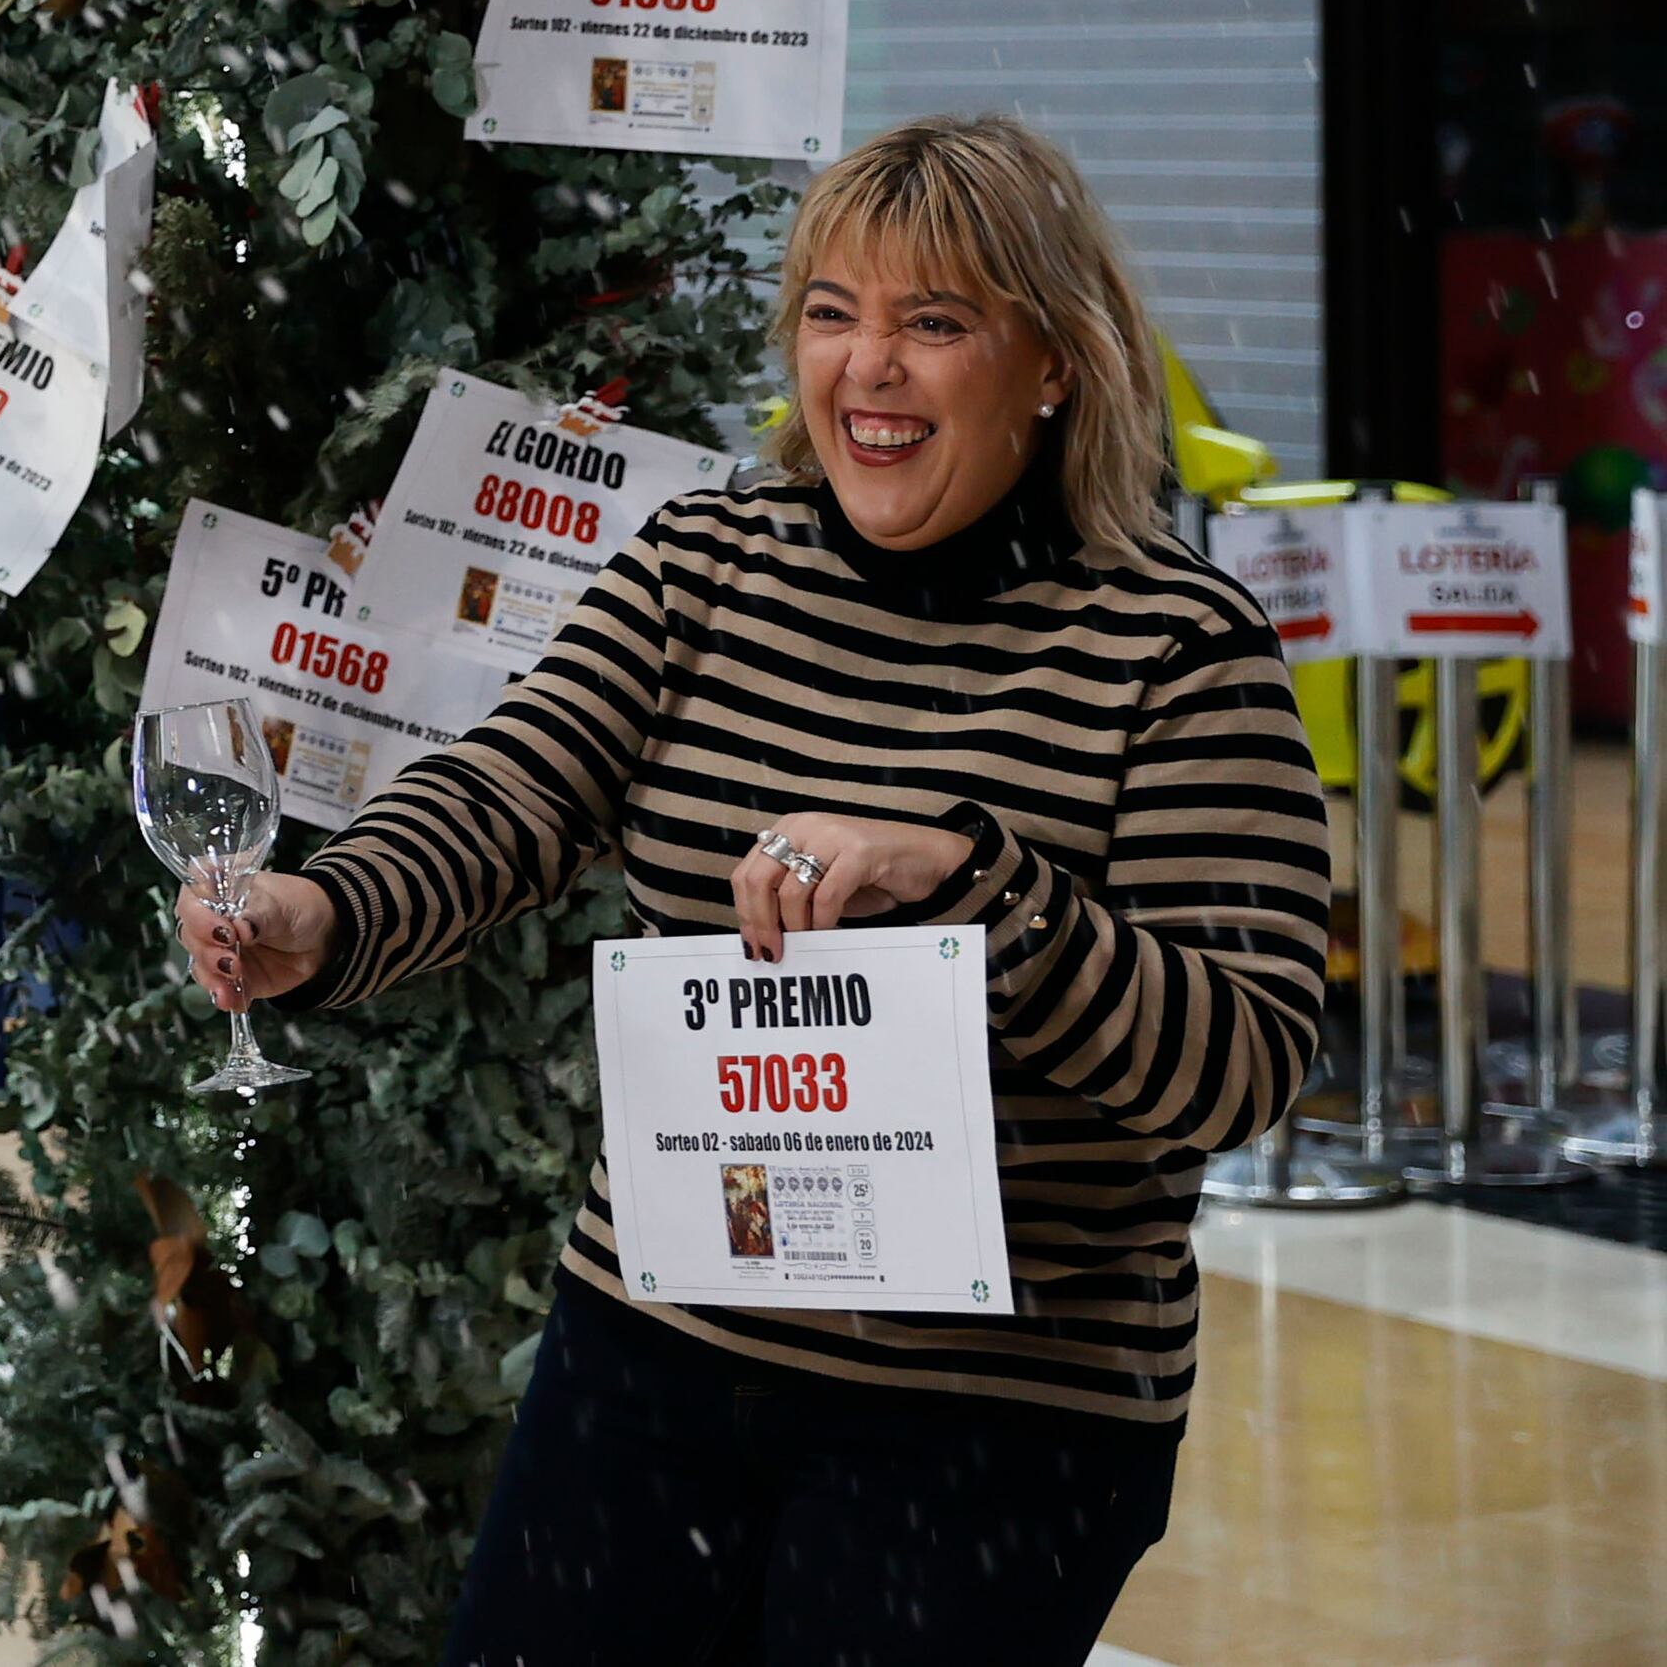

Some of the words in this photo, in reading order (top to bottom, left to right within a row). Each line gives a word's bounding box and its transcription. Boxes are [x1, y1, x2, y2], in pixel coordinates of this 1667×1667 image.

[485, 420, 515, 457] EL
[516, 424, 627, 491] GORDO
[474, 473, 601, 546] 88008
[261, 557, 300, 599] 5º
[271, 621, 390, 695] 01568
[683, 977, 720, 1031] 3º
[728, 972, 872, 1029] PREMIO
[717, 1052, 848, 1113] 57033
[655, 1132, 700, 1152] Sorteo
[701, 1132, 720, 1152] 02
[729, 1131, 781, 1152] sabado
[783, 1131, 803, 1152] 06
[804, 1132, 824, 1152] de
[825, 1134, 870, 1152] enero
[872, 1131, 893, 1152] de
[894, 1130, 934, 1152] 2024
